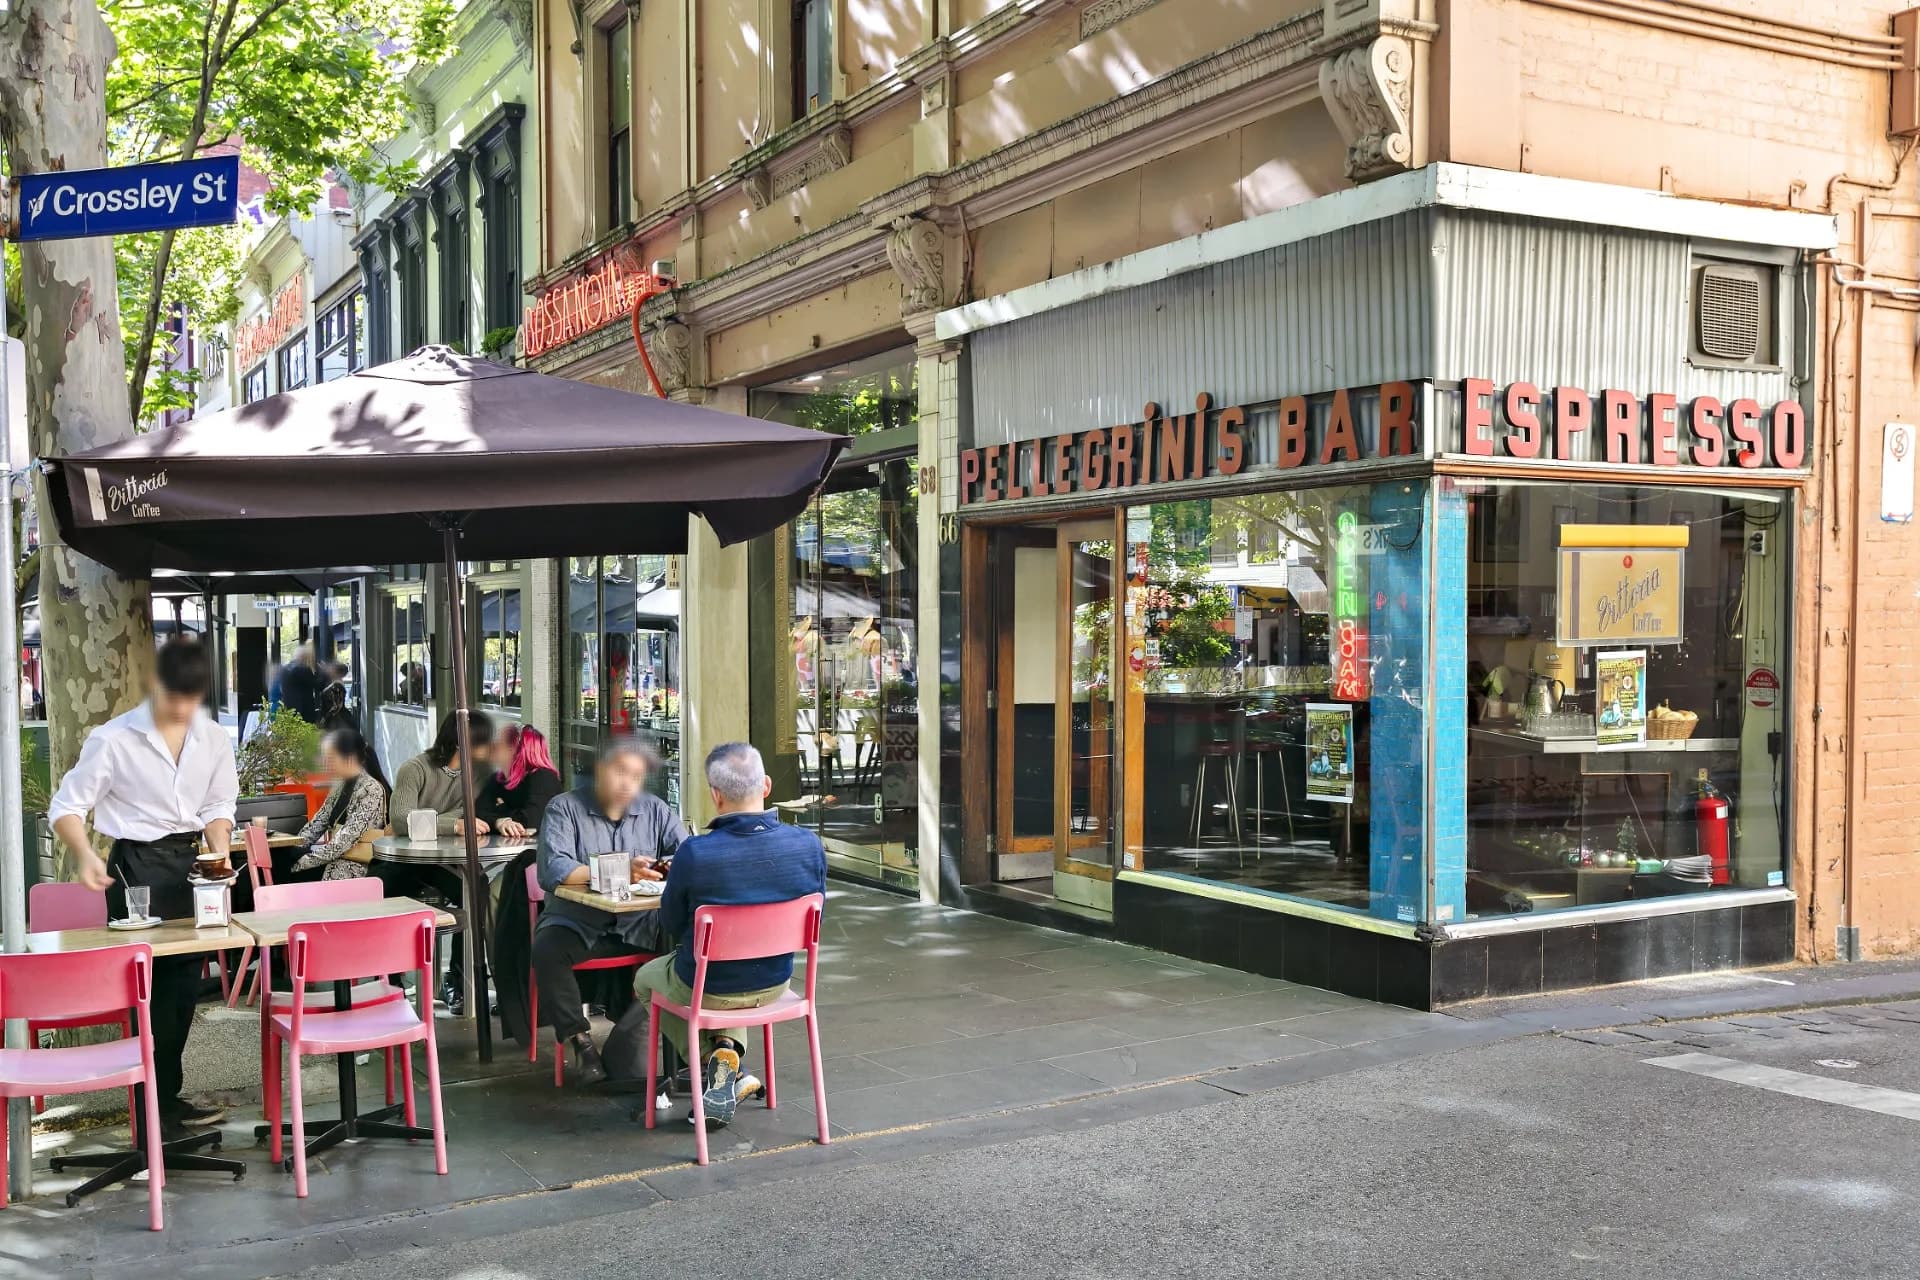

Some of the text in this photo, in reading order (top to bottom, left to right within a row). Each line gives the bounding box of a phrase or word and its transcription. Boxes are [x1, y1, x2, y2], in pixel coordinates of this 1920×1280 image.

[53, 172, 227, 216] Crossley St
[574, 260, 623, 334] NOVA
[1277, 381, 1414, 469] BAR
[1462, 378, 1806, 469] ESPRESSO
[108, 469, 169, 512] Vittoria
[132, 502, 161, 518] Coffee
[940, 513, 959, 545] 66
[1597, 567, 1660, 633] Vittoria
